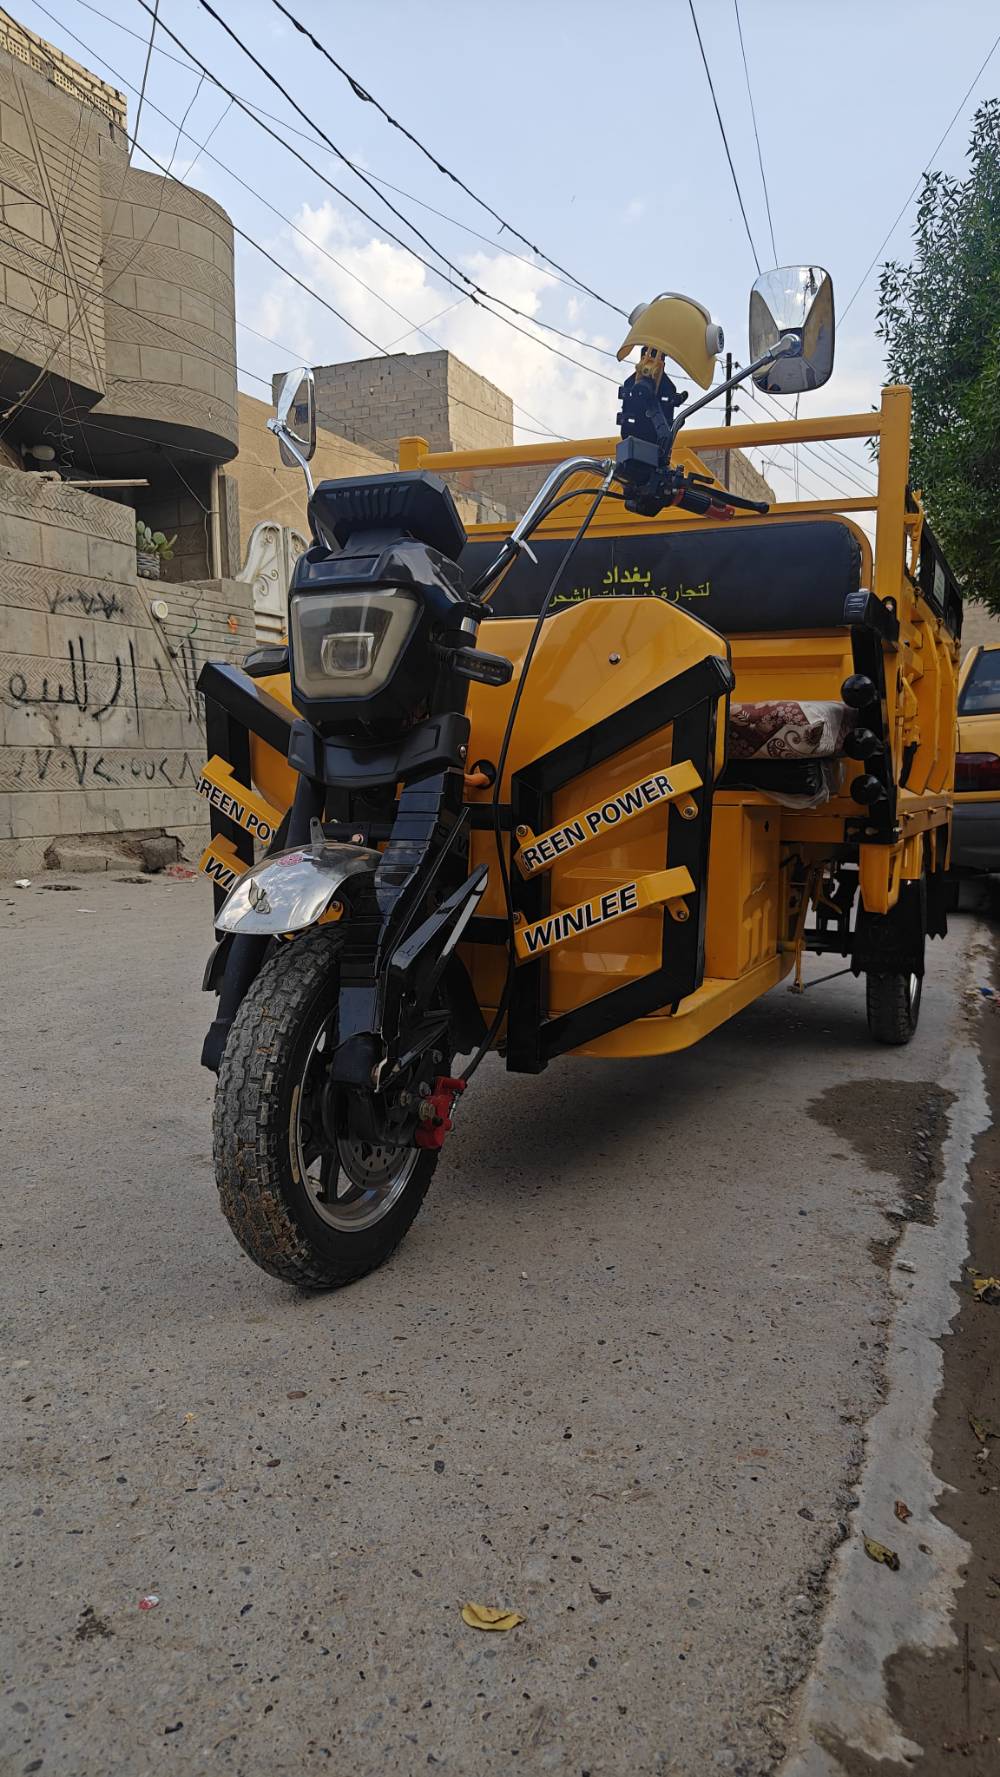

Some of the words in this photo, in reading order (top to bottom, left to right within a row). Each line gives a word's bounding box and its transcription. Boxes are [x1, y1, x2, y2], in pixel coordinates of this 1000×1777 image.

[603, 566, 651, 588] بغداد
[660, 582, 710, 604] لتجارة
[195, 775, 245, 822] REEN
[246, 813, 276, 843] PO
[520, 821, 586, 871] REEN
[586, 775, 674, 834] POWER
[205, 856, 236, 892] WI
[523, 884, 639, 952] WINLEE
